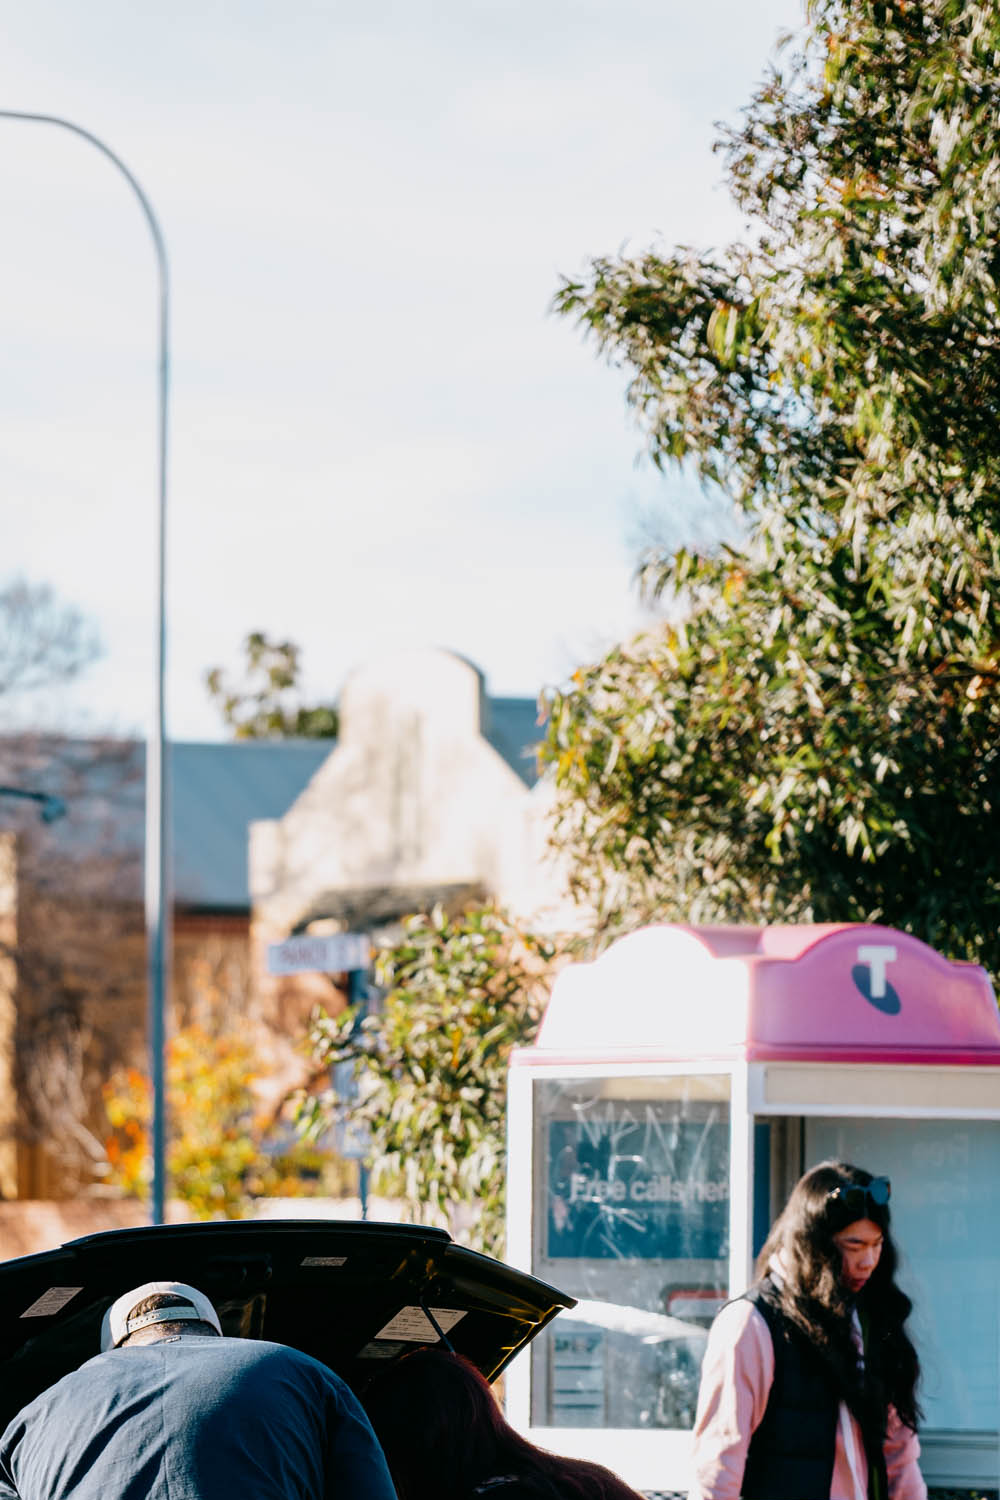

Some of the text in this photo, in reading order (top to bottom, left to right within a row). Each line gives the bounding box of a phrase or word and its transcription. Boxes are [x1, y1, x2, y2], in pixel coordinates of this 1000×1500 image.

[857, 945, 897, 998] T
[570, 1174, 730, 1203] Free calls her
